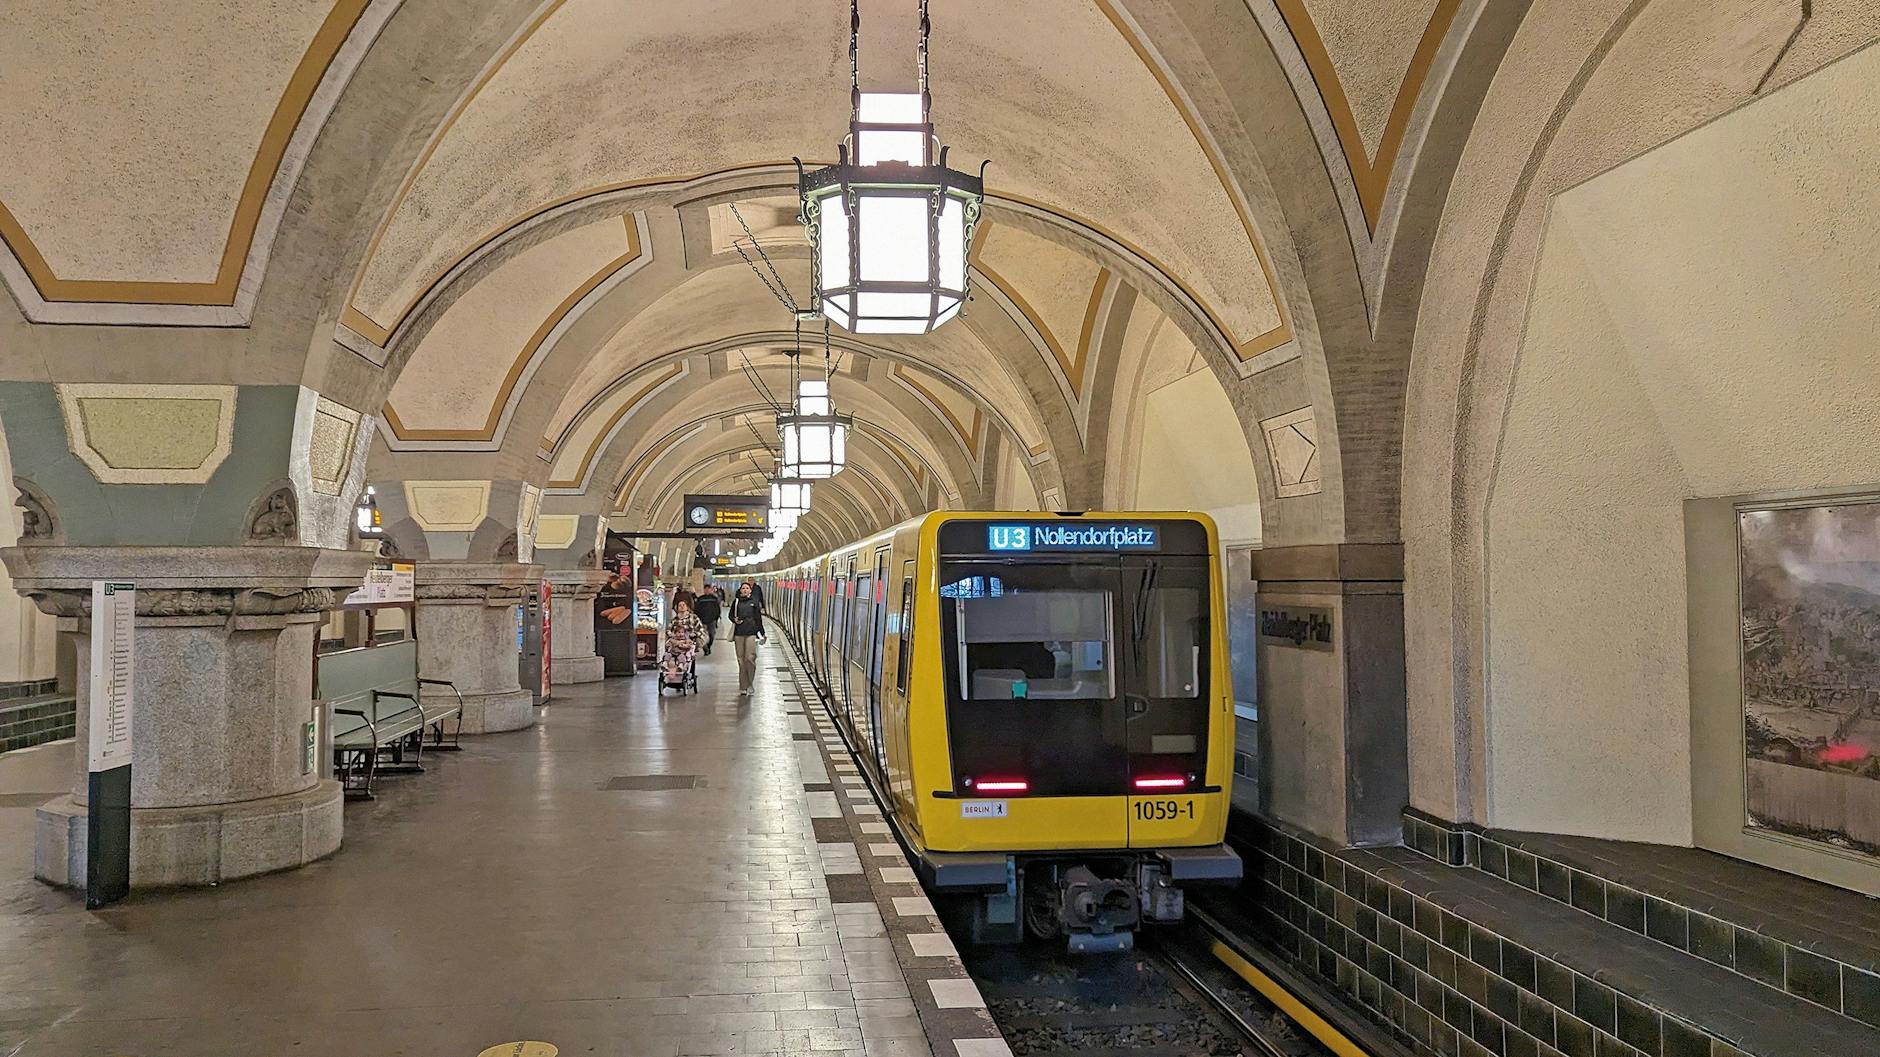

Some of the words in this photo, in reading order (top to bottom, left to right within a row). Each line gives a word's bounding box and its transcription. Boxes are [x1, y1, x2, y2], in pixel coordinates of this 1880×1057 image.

[1034, 526, 1154, 549] Nollendorfplatz
[105, 583, 115, 595] U3
[964, 806, 990, 814] BERLIN
[1134, 800, 1194, 820] 1059-1
